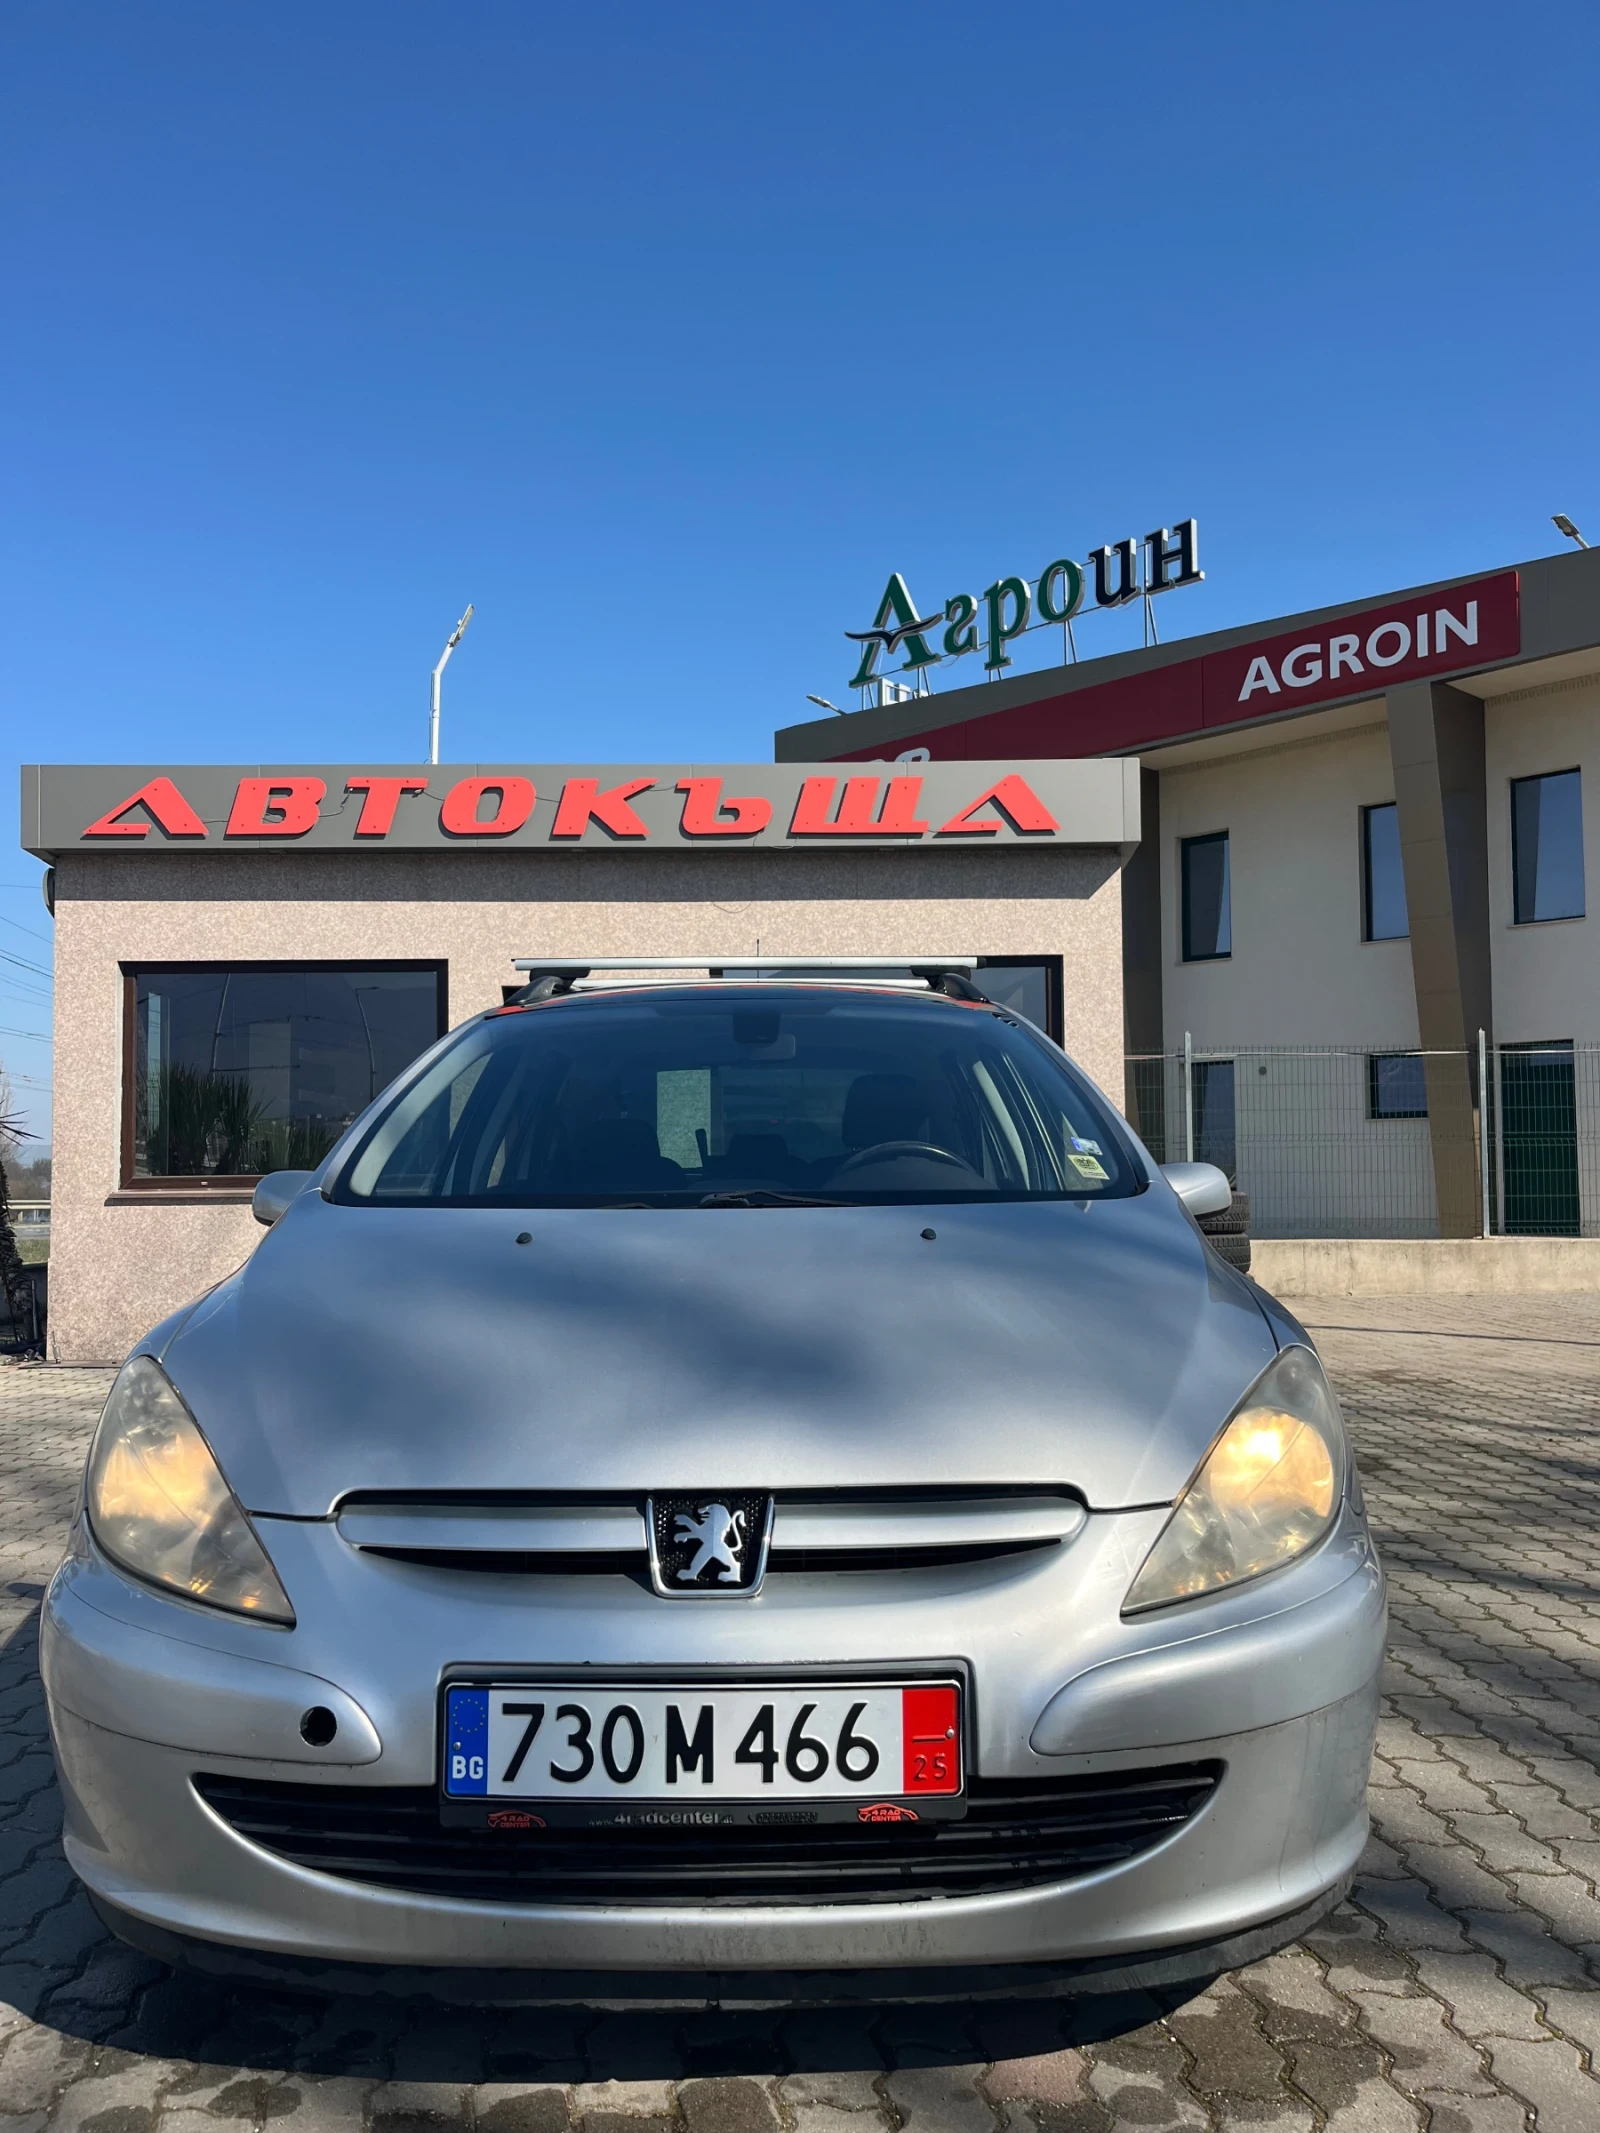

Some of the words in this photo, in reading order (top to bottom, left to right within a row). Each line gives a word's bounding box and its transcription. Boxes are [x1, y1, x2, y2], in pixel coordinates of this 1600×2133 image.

[845, 517, 1206, 688] Агроин
[1237, 600, 1480, 702] AGROIN
[83, 775, 1056, 842] АВТОКЪЩА
[451, 1754, 485, 1779] BG
[501, 1703, 646, 1783] 730
[664, 1704, 715, 1784] M
[734, 1703, 881, 1783] 466
[912, 1752, 948, 1782] 25
